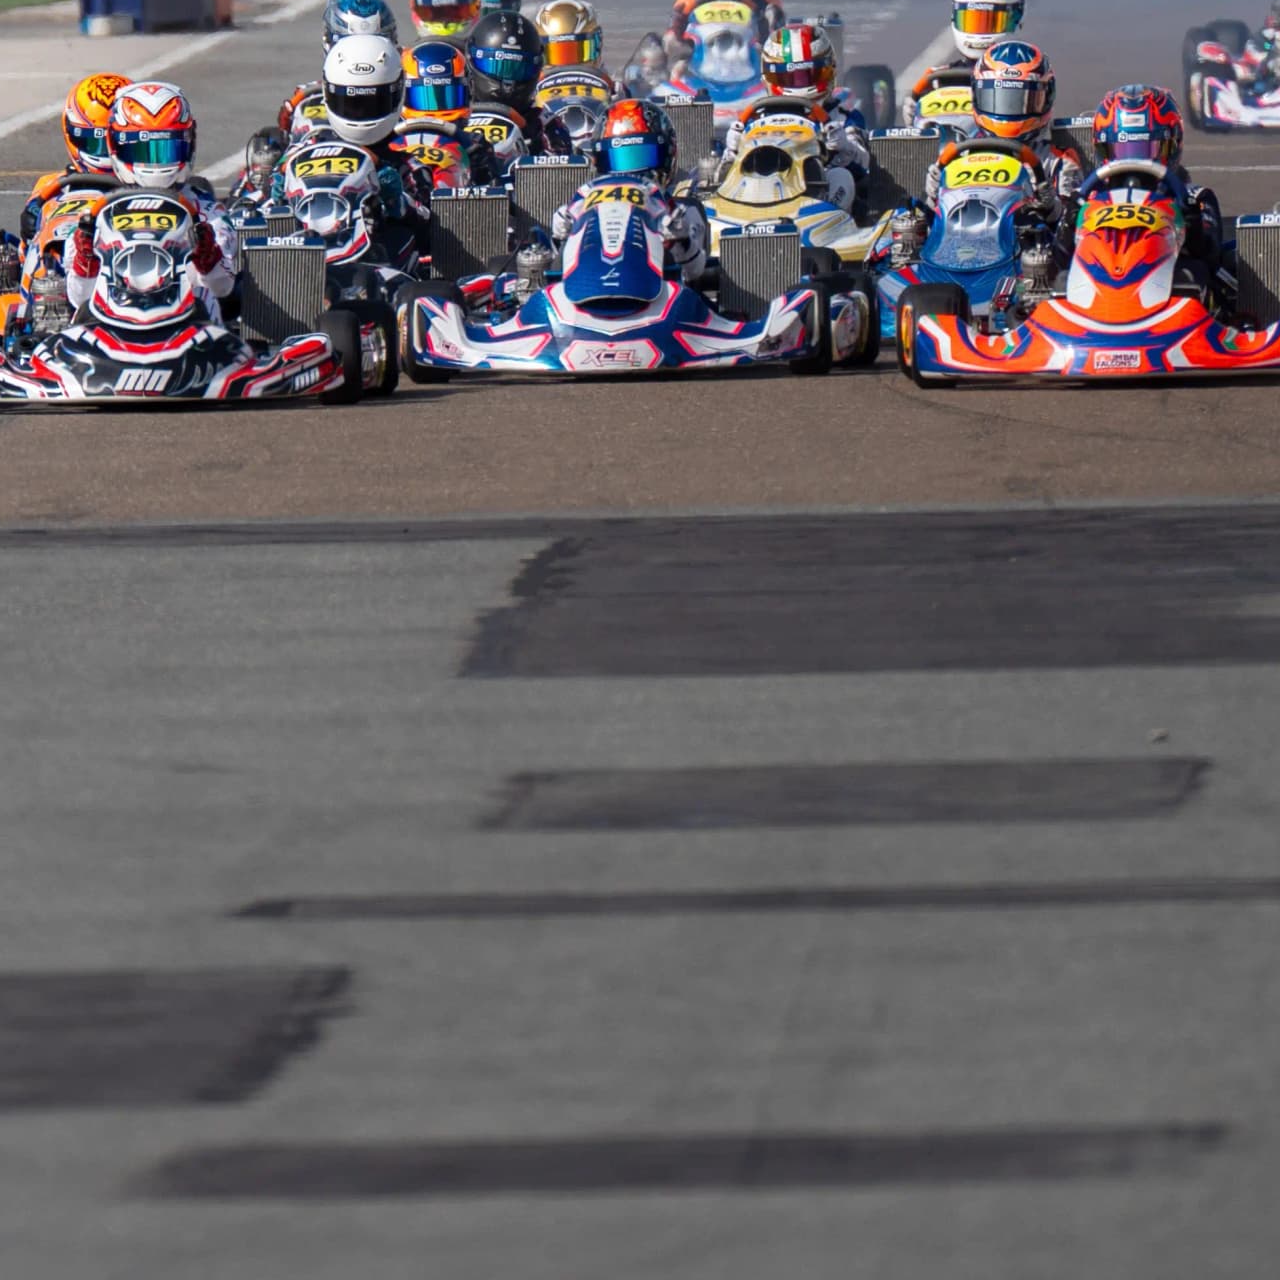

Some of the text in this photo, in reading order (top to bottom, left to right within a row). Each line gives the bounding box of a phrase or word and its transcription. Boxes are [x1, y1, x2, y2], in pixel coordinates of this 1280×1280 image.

[298, 158, 356, 179] 213
[952, 169, 1012, 187] 260
[583, 187, 646, 209] 248
[116, 214, 176, 232] 219
[1095, 204, 1158, 227] 255
